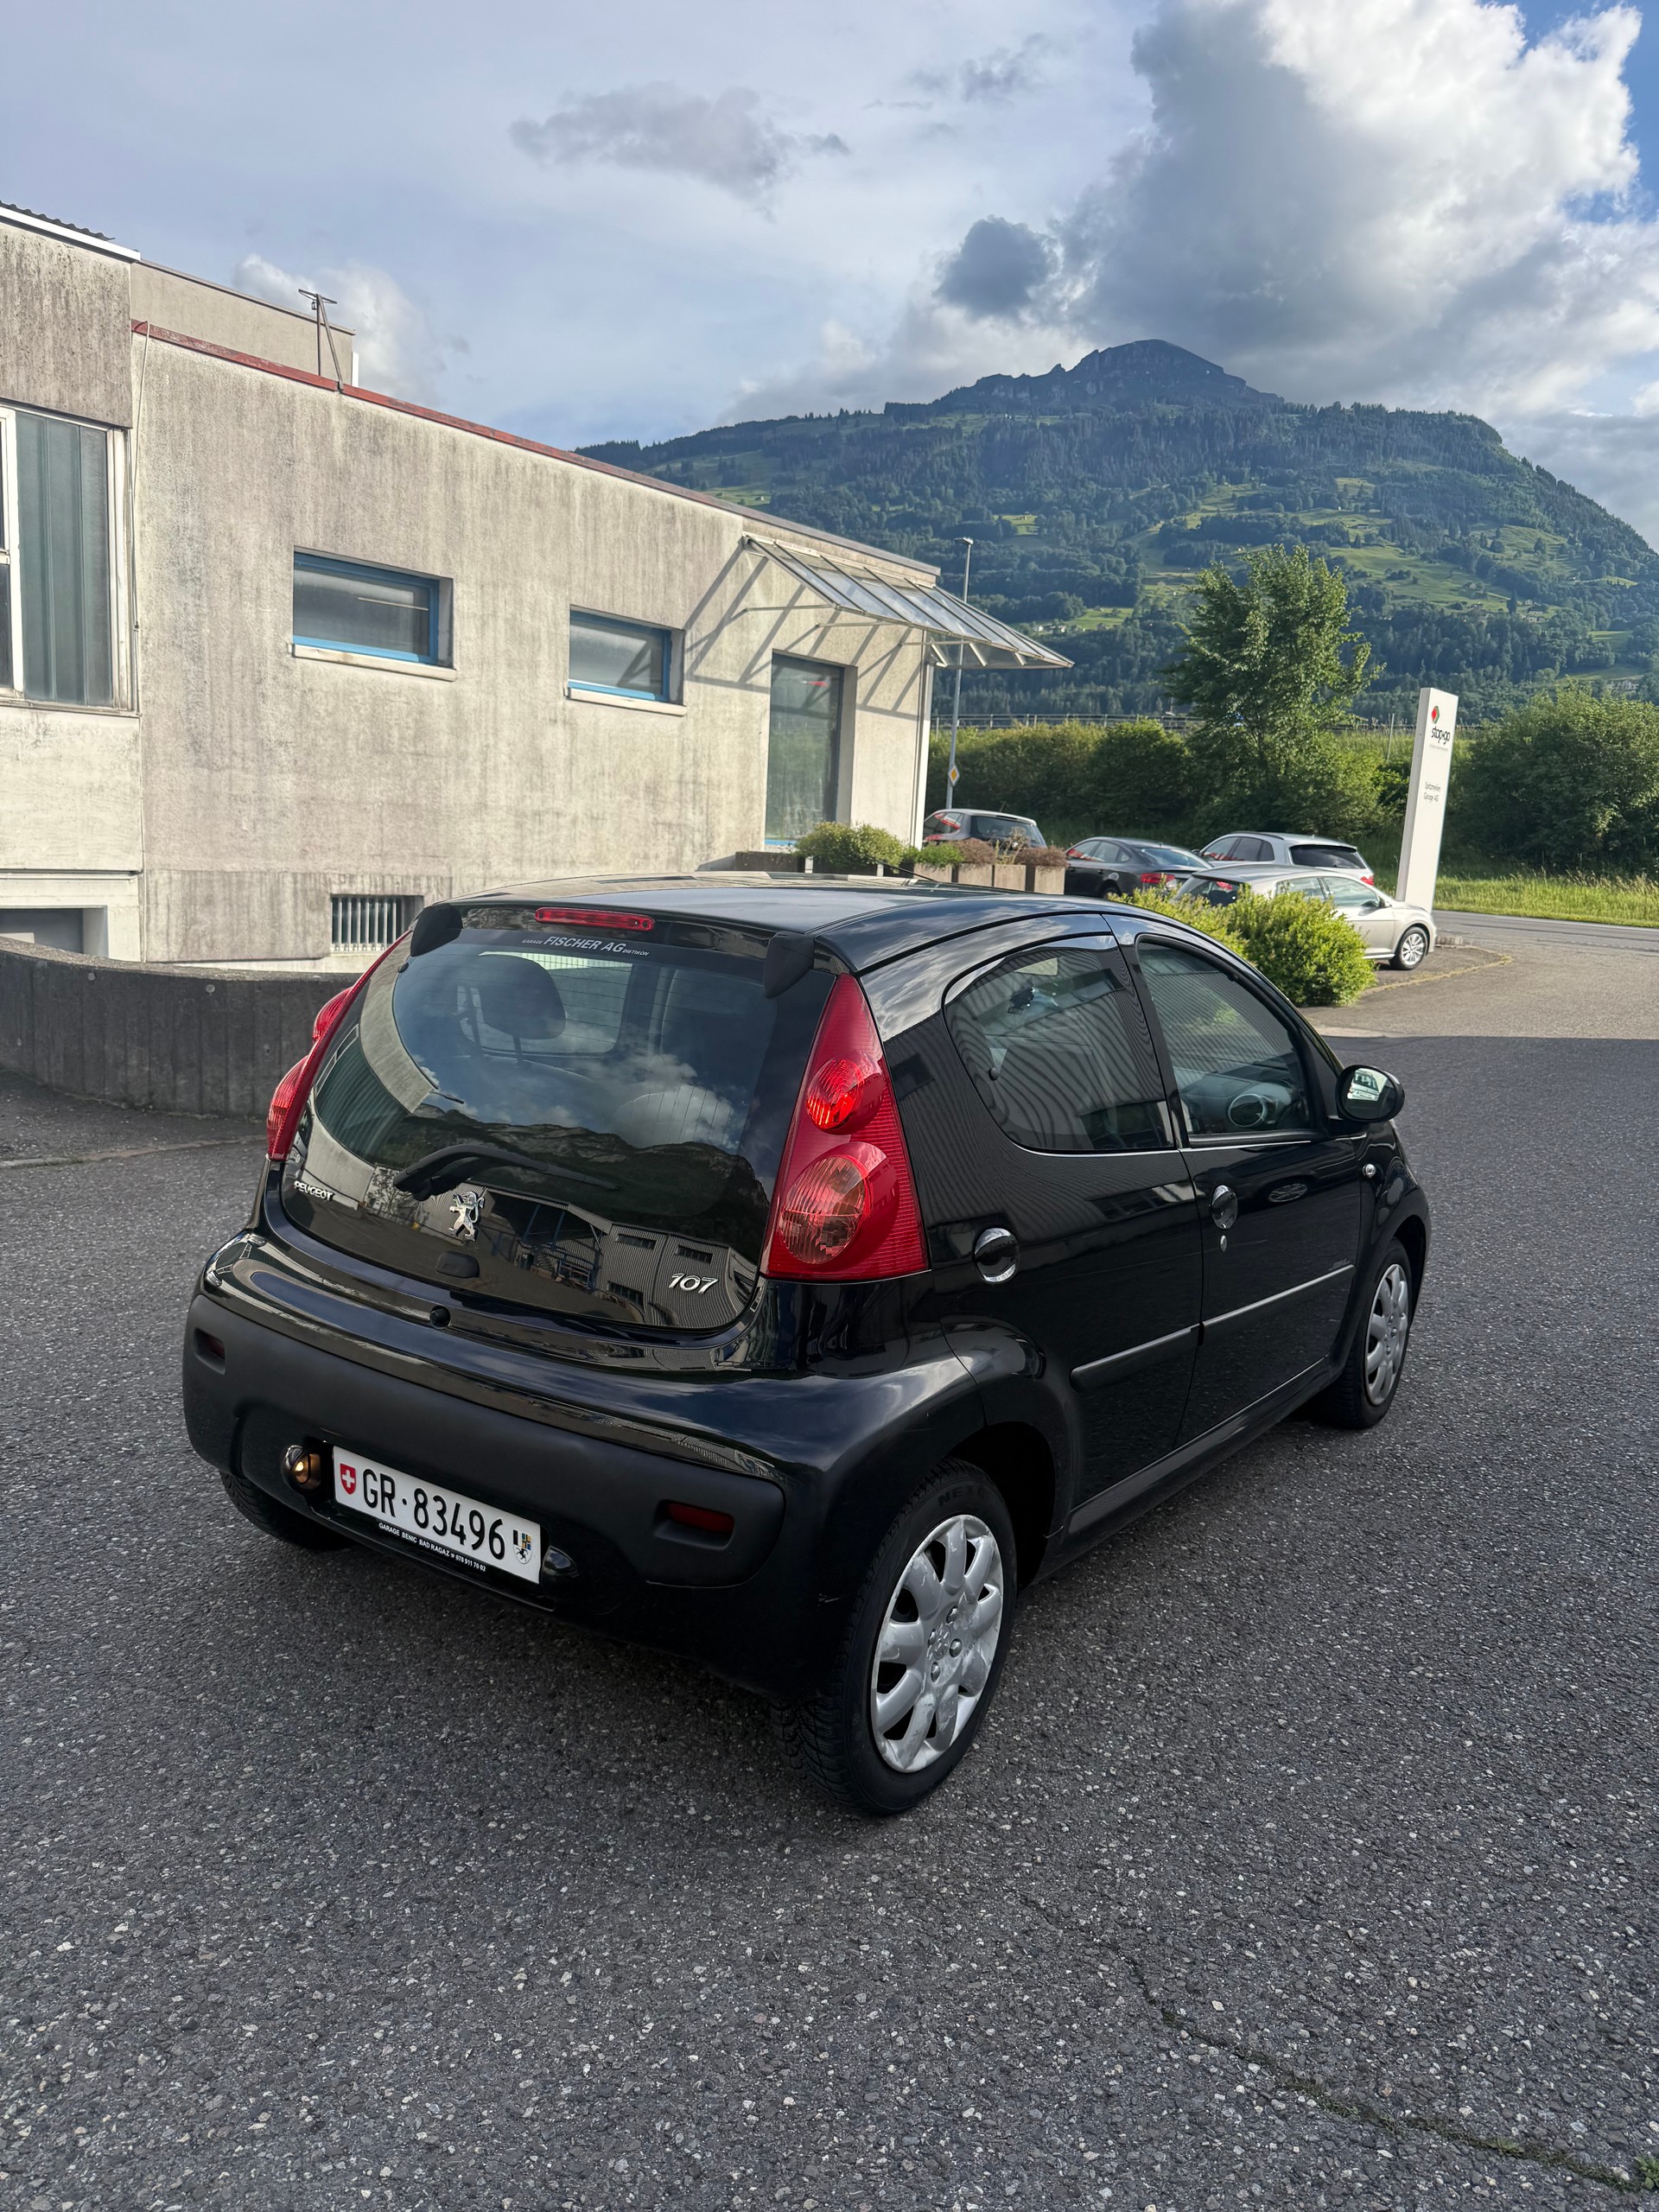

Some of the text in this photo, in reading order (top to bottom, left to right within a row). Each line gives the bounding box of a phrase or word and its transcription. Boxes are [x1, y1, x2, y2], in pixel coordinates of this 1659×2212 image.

[543, 936, 602, 950] FISCHER
[601, 942, 626, 953] AG
[294, 1180, 334, 1201] PEUGEOT
[669, 1273, 719, 1294] 107
[378, 1522, 400, 1535] GARAGE
[419, 1539, 430, 1548] BAD
[430, 1543, 449, 1557] RAGAZ
